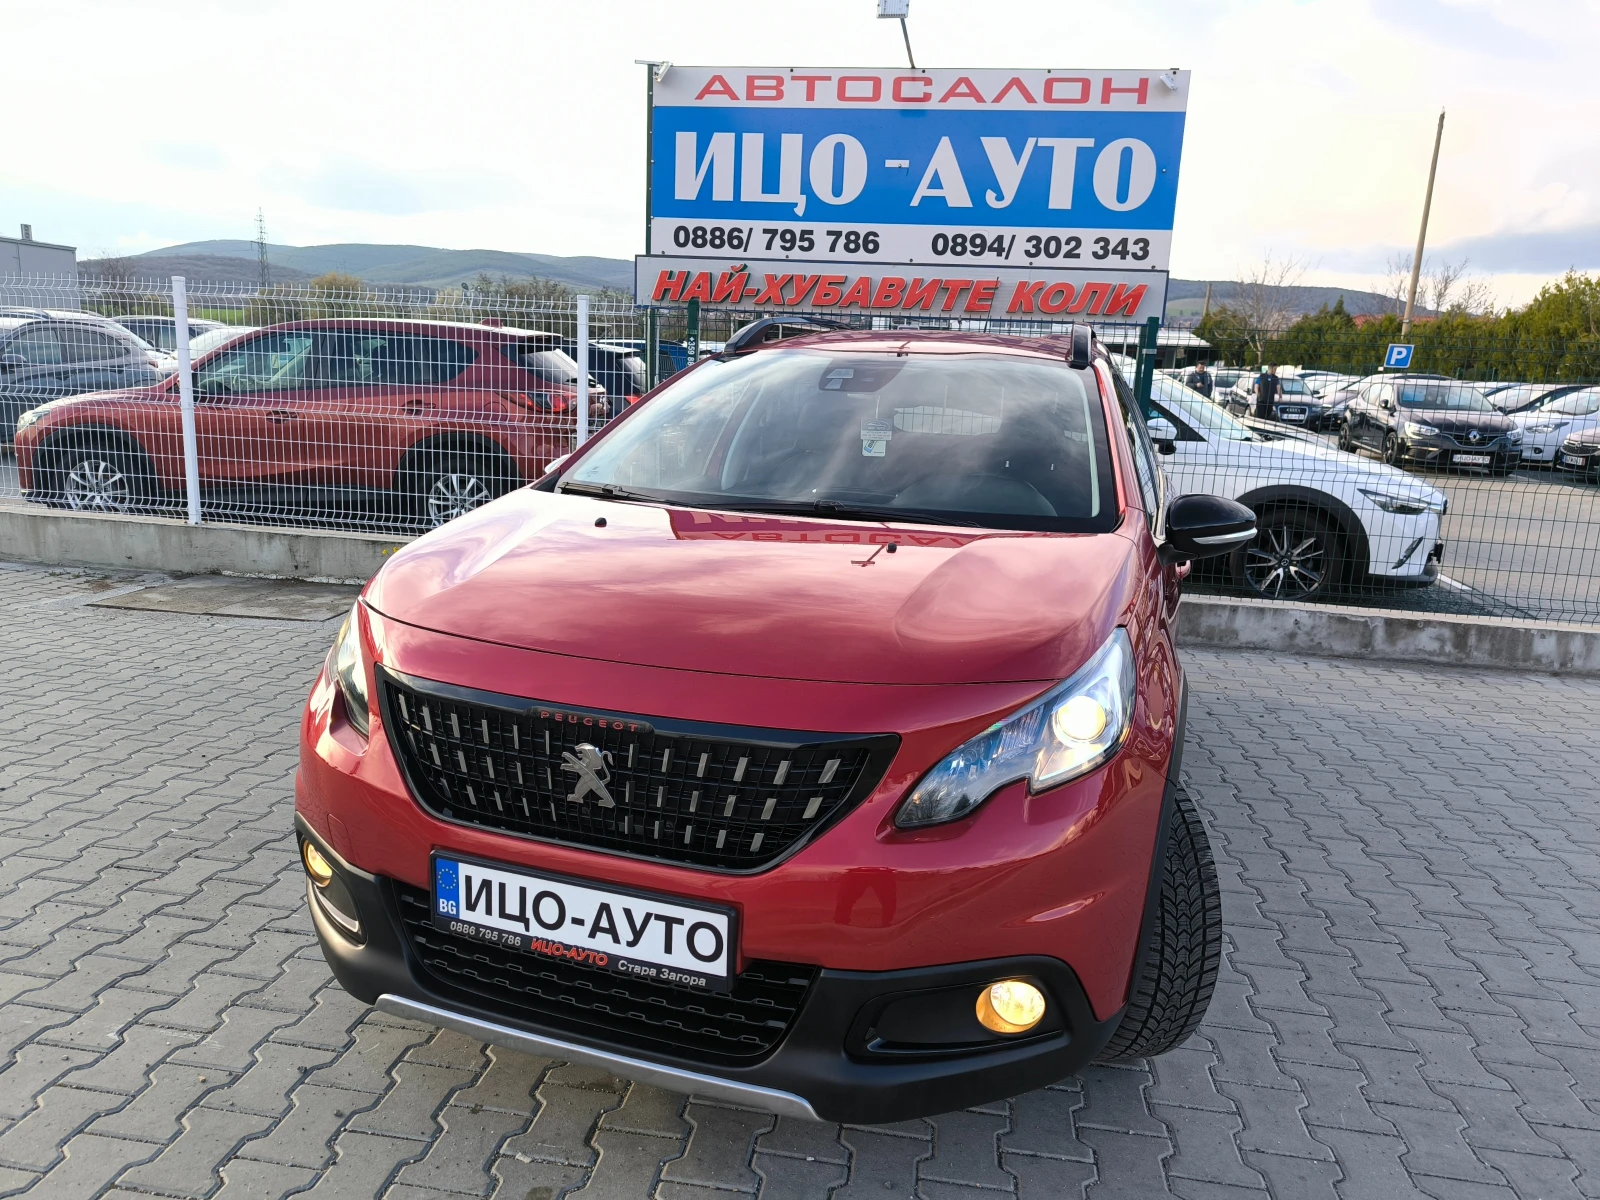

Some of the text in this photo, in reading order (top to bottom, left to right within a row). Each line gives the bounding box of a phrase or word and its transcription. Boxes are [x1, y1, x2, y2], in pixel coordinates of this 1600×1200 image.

[694, 75, 1149, 105] АВТОСАЛОН
[762, 228, 815, 252] 795
[826, 230, 880, 254] 786
[1024, 235, 1082, 259] 302
[1091, 237, 1150, 261] 343
[651, 263, 1148, 316] НАЙ-ХУБАВИТЕ КОЛИ
[1390, 347, 1407, 365] P
[541, 710, 638, 732] PEUGEOT
[439, 898, 457, 915] BG
[464, 874, 724, 963] ИЦО-АУТО
[450, 921, 521, 946] 0886 795 786
[530, 937, 608, 966] ИЦО-АУТО
[618, 960, 706, 987] Стара Загора
